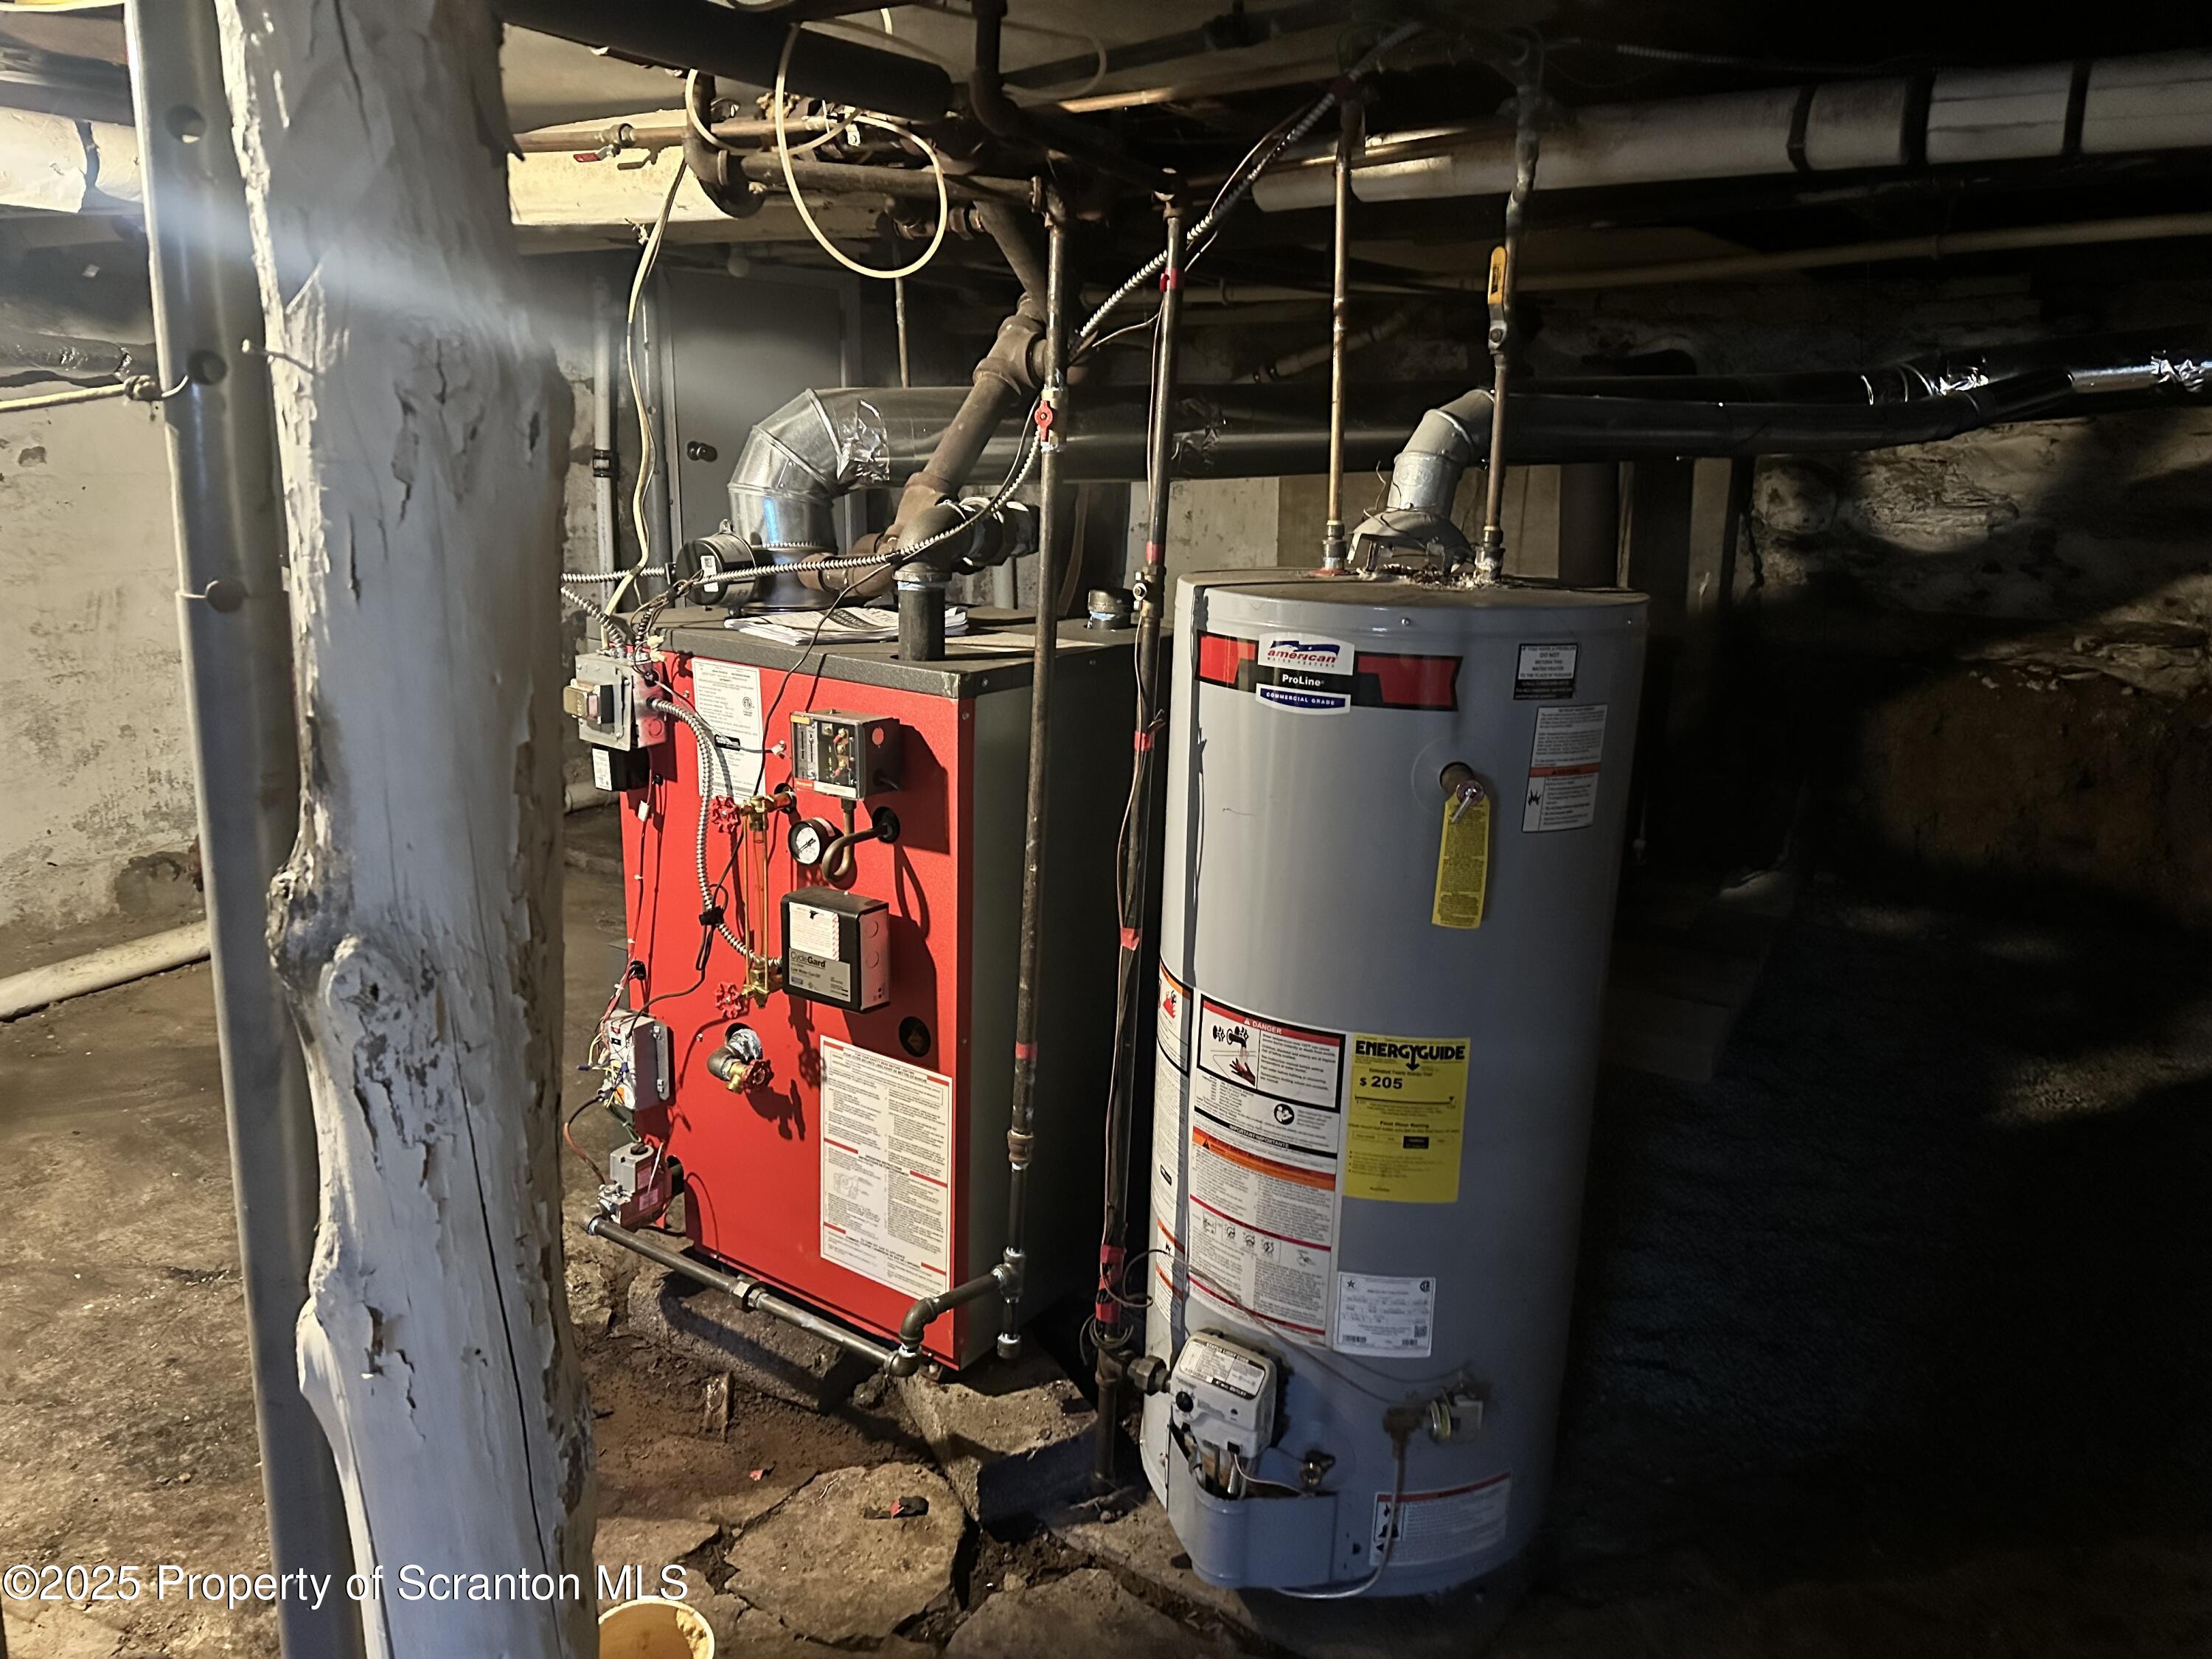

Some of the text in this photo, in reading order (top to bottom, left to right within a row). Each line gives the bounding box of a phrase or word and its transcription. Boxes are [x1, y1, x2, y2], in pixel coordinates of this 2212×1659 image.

[1267, 650, 1336, 663] american
[1267, 692, 1308, 702] COMMERCIAL
[1253, 1020, 1281, 1034] DANGER
[1355, 1040, 1466, 1061] ENERGYGUIDE
[1360, 1076, 1402, 1089] $ 205
